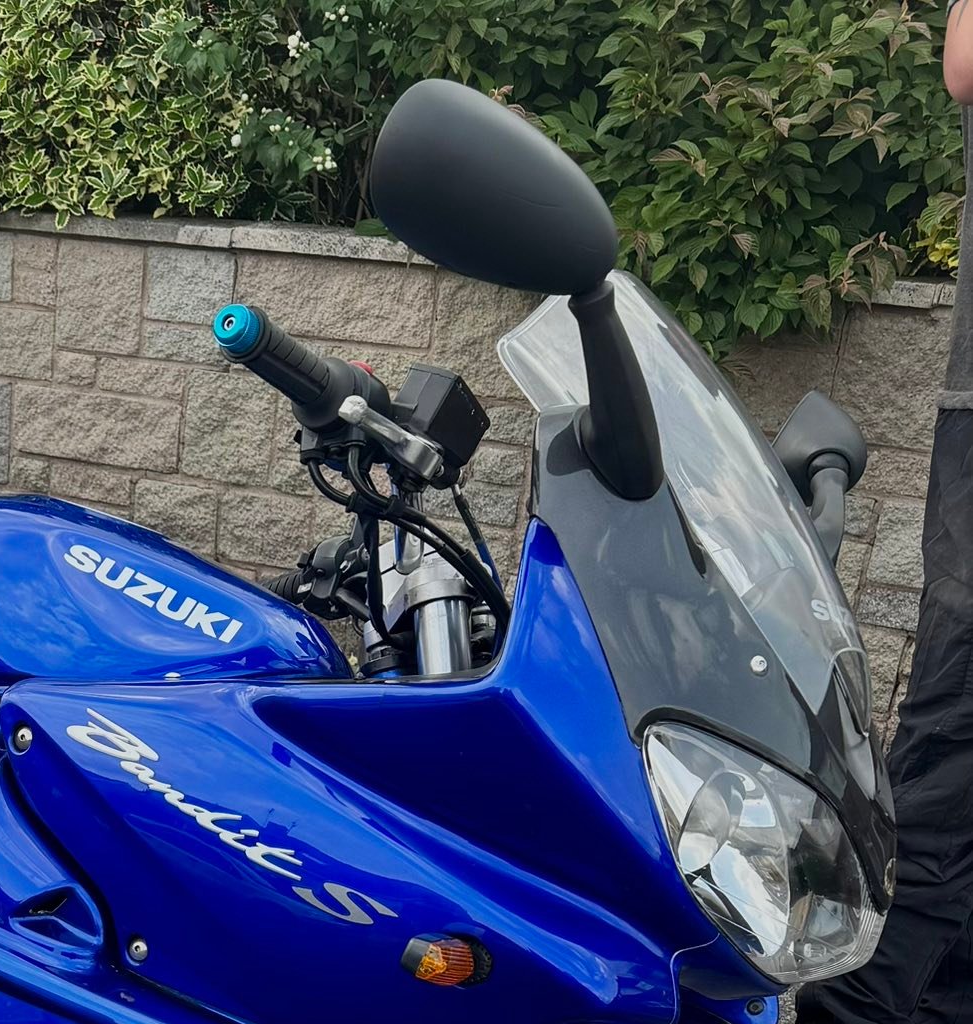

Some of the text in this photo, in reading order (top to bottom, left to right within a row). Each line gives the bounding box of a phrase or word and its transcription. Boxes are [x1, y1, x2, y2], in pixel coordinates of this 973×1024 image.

[64, 544, 244, 643] SUZUKI
[66, 708, 400, 925] Bandit S
